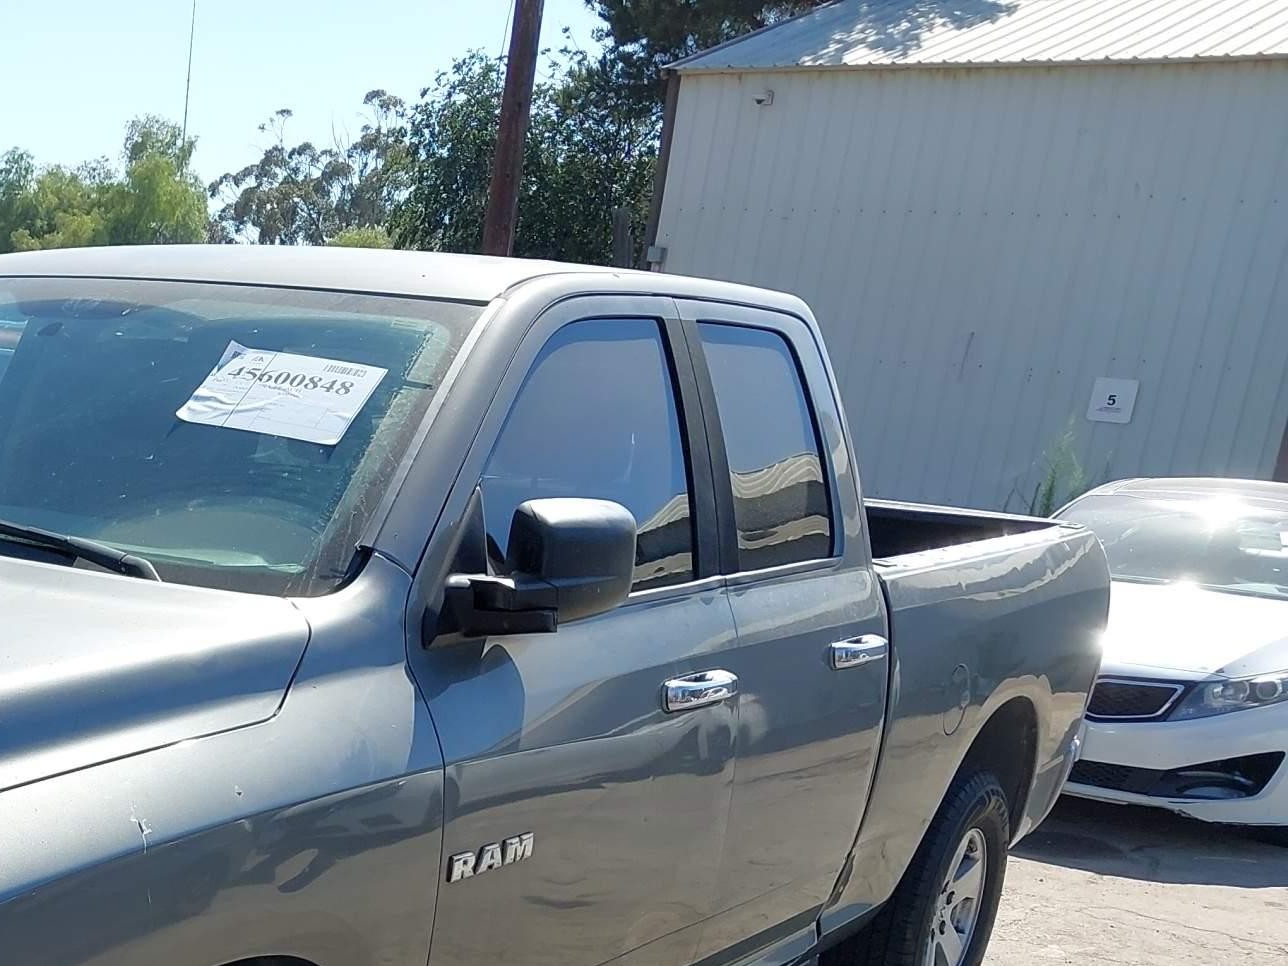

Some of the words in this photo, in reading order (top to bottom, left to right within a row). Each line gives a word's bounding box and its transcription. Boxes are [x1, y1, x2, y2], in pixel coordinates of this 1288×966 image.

[227, 365, 355, 396] 45600848
[1106, 394, 1117, 406] 5
[446, 831, 534, 883] RAM
